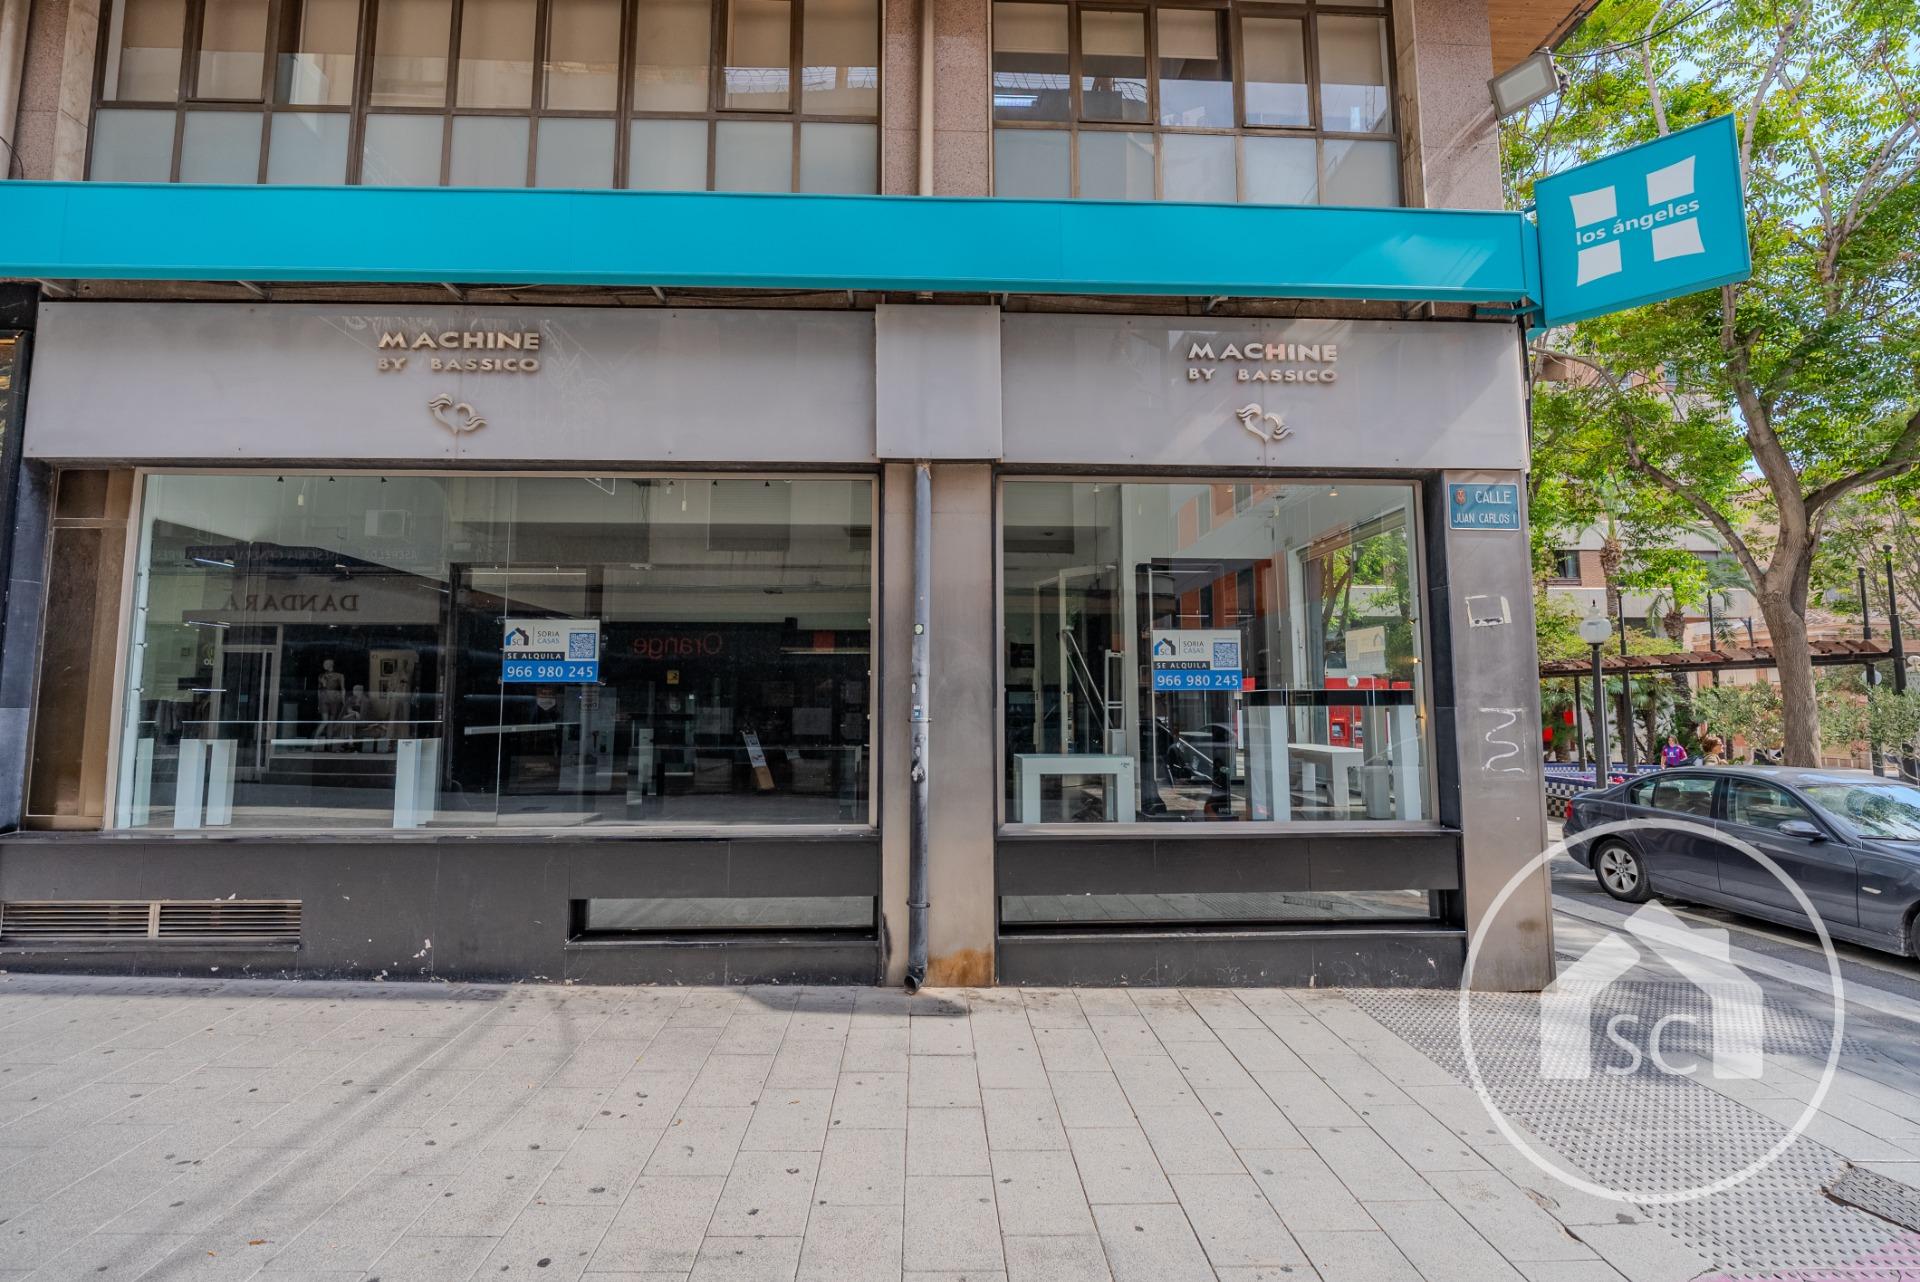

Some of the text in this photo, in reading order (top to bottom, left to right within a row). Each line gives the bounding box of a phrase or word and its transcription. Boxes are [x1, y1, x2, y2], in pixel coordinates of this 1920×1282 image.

[1576, 200, 1700, 245] los ángeles
[378, 331, 541, 350] MACHINE
[1188, 342, 1338, 362] MACHINE
[378, 357, 540, 372] BY BASSICO
[1188, 367, 1338, 383] BY BASSICO
[1475, 490, 1512, 504] CALLE
[1453, 512, 1475, 523] JUAN
[1479, 512, 1510, 524] CARLOS
[507, 652, 561, 660] SE ALQUILA
[507, 666, 593, 678] 966 980 245
[1157, 675, 1238, 686] 966 980 245
